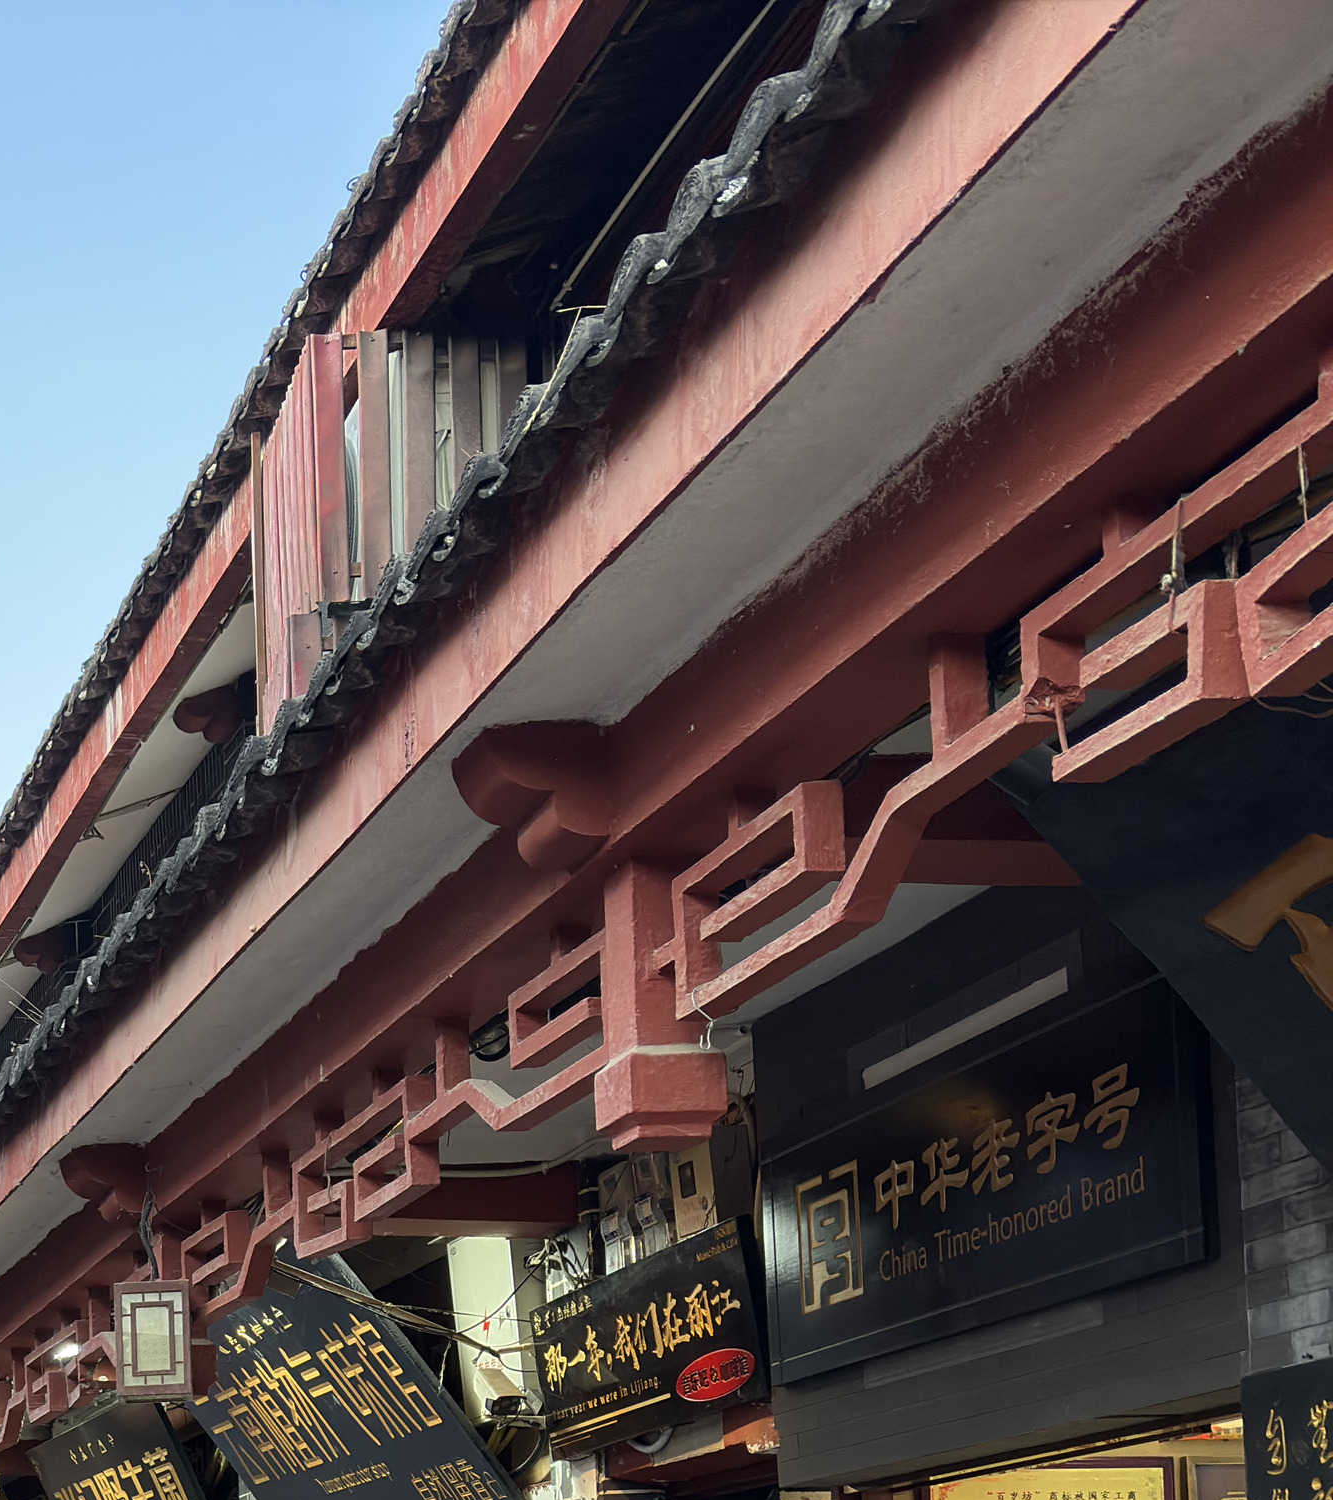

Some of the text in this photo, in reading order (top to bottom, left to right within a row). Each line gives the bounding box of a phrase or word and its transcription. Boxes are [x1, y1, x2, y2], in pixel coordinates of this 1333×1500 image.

[874, 1062, 1140, 1230] 中华老字号
[879, 1156, 1145, 1283] China Time-honored Brand
[194, 1312, 442, 1485] 云南植物气味馆
[588, 1398, 599, 1410] we
[600, 1394, 618, 1408] were
[619, 1388, 629, 1401] in
